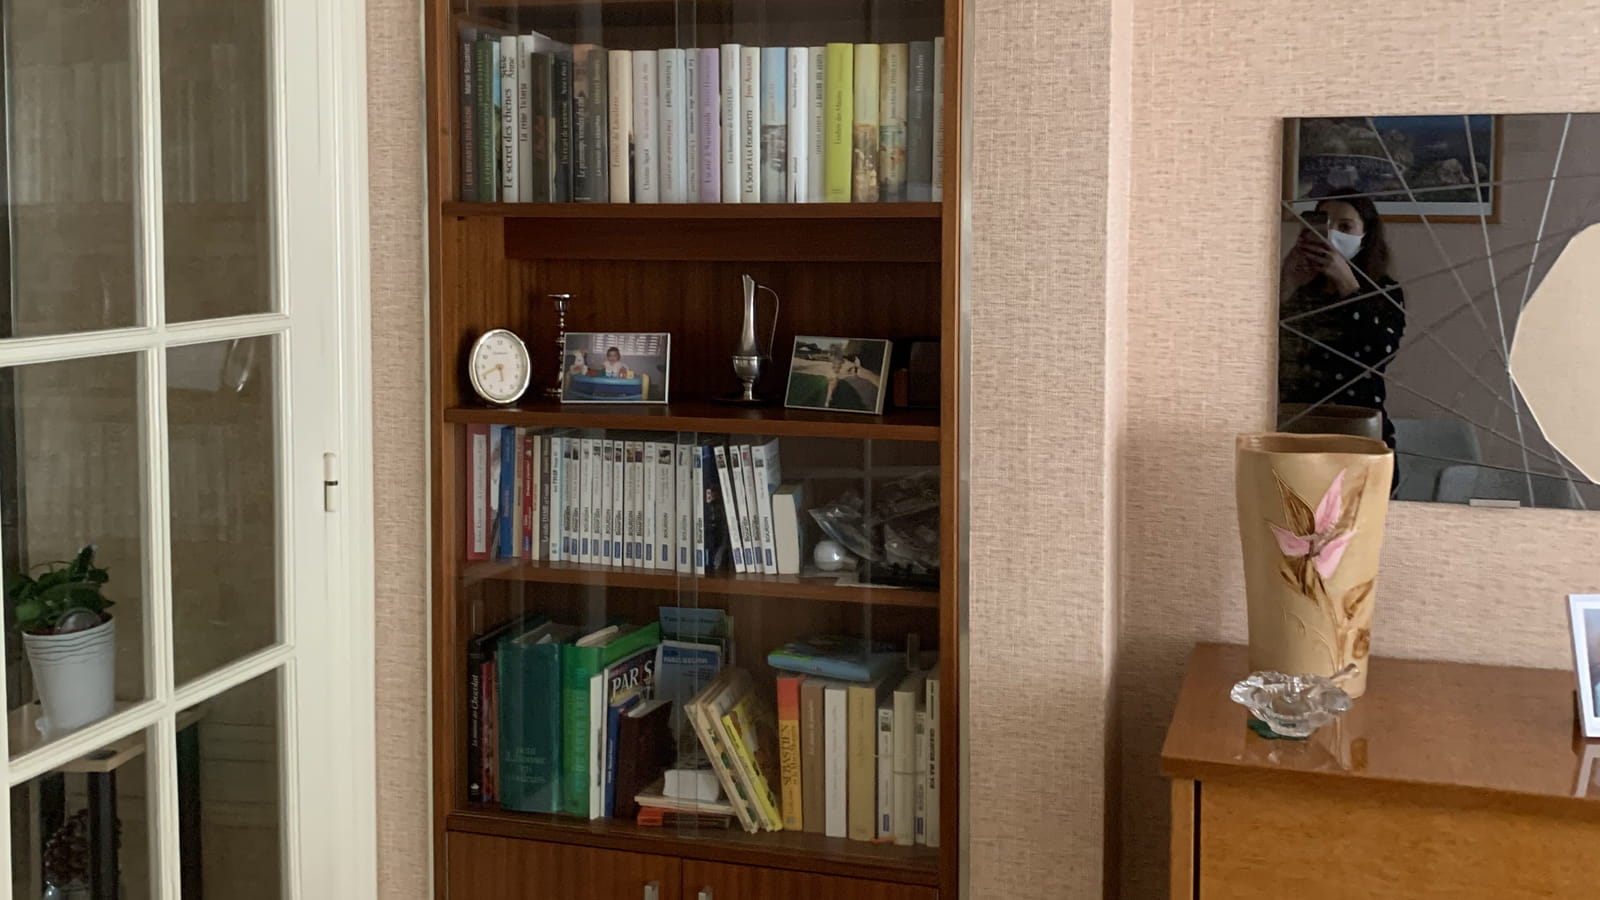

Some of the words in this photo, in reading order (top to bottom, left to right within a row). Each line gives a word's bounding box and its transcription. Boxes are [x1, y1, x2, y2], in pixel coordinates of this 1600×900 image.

[503, 126, 512, 143] des
[503, 146, 512, 174] secret
[503, 176, 513, 188] Le
[470, 674, 478, 709] Chocolat
